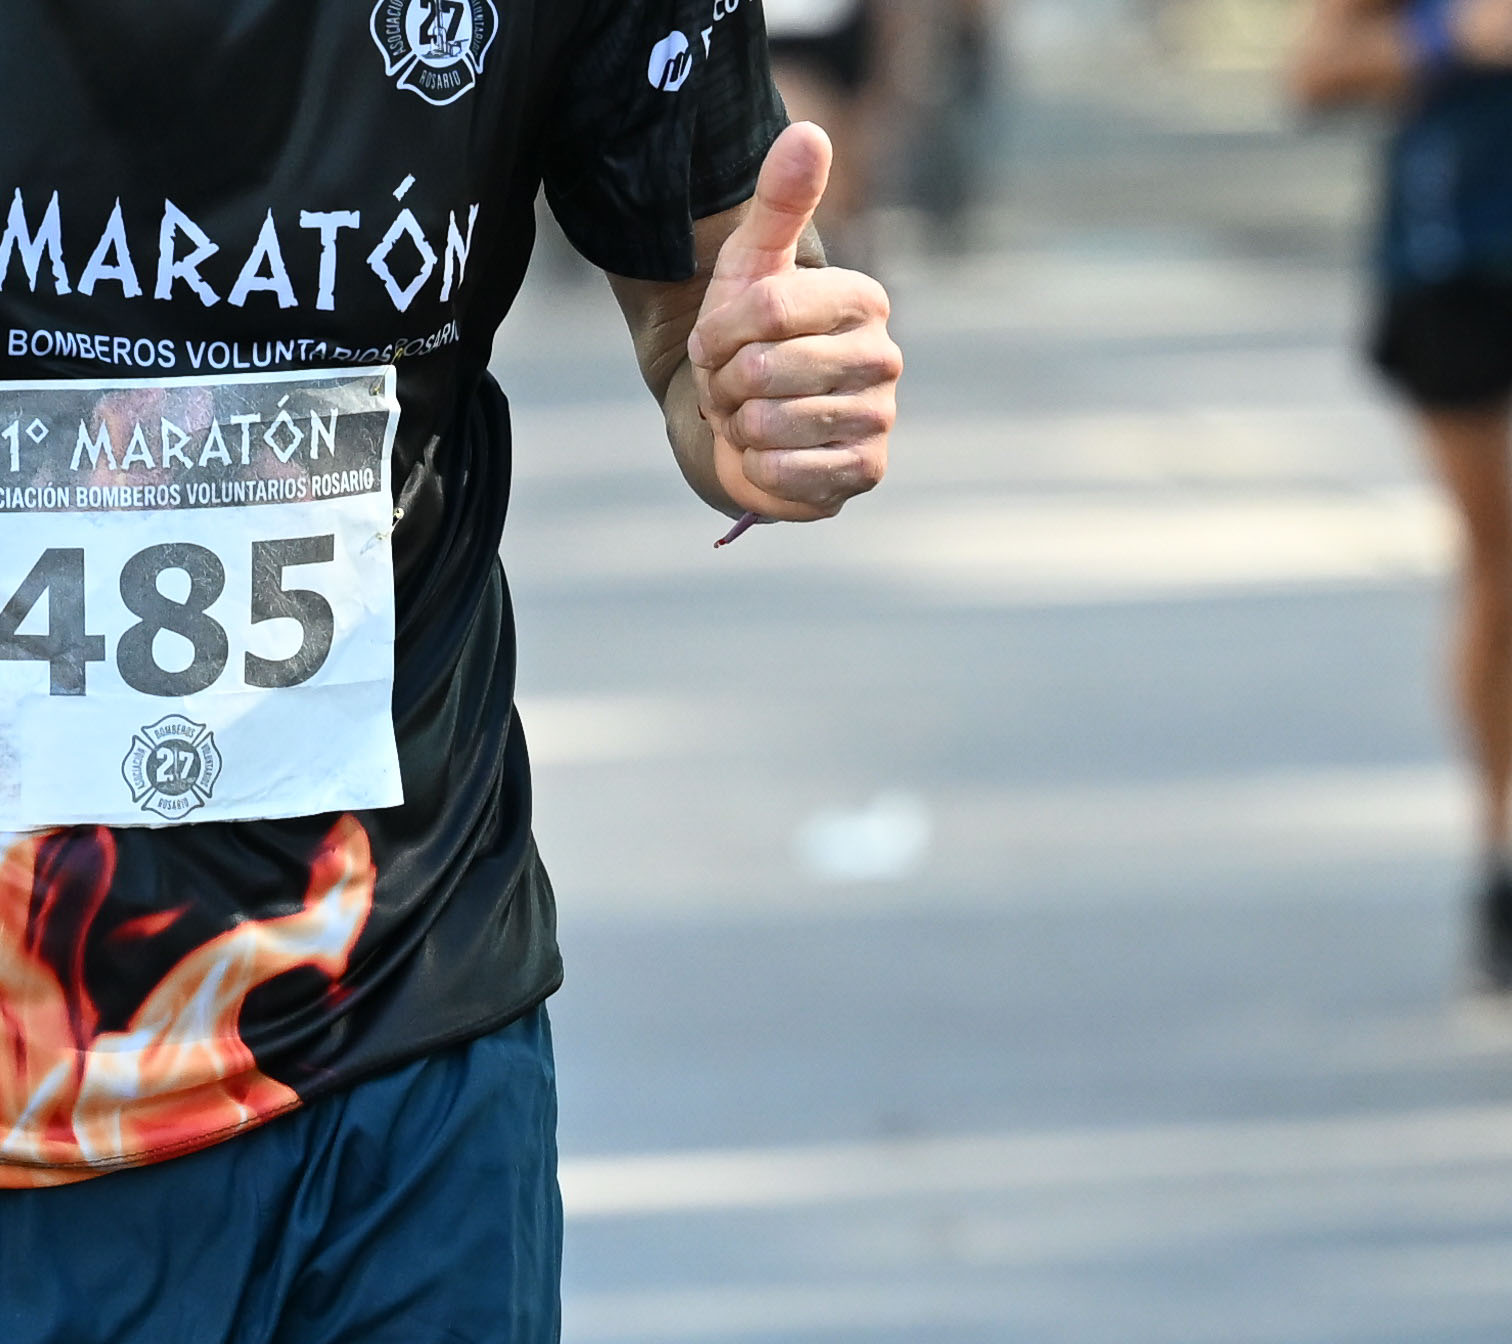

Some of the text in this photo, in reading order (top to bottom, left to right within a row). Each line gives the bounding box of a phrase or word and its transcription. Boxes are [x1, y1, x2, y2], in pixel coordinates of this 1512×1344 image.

[419, 69, 462, 91] ROSARIO
[7, 328, 177, 369] BOMBEROS
[69, 394, 339, 471] MARATÓN
[76, 484, 182, 508] BOMBEROS
[186, 474, 308, 506] VOLUNTARIOS
[311, 467, 374, 497] ROSARIO
[154, 724, 196, 739] BOMBEROS
[156, 746, 195, 783] 27
[158, 797, 189, 810] ROSARIO
